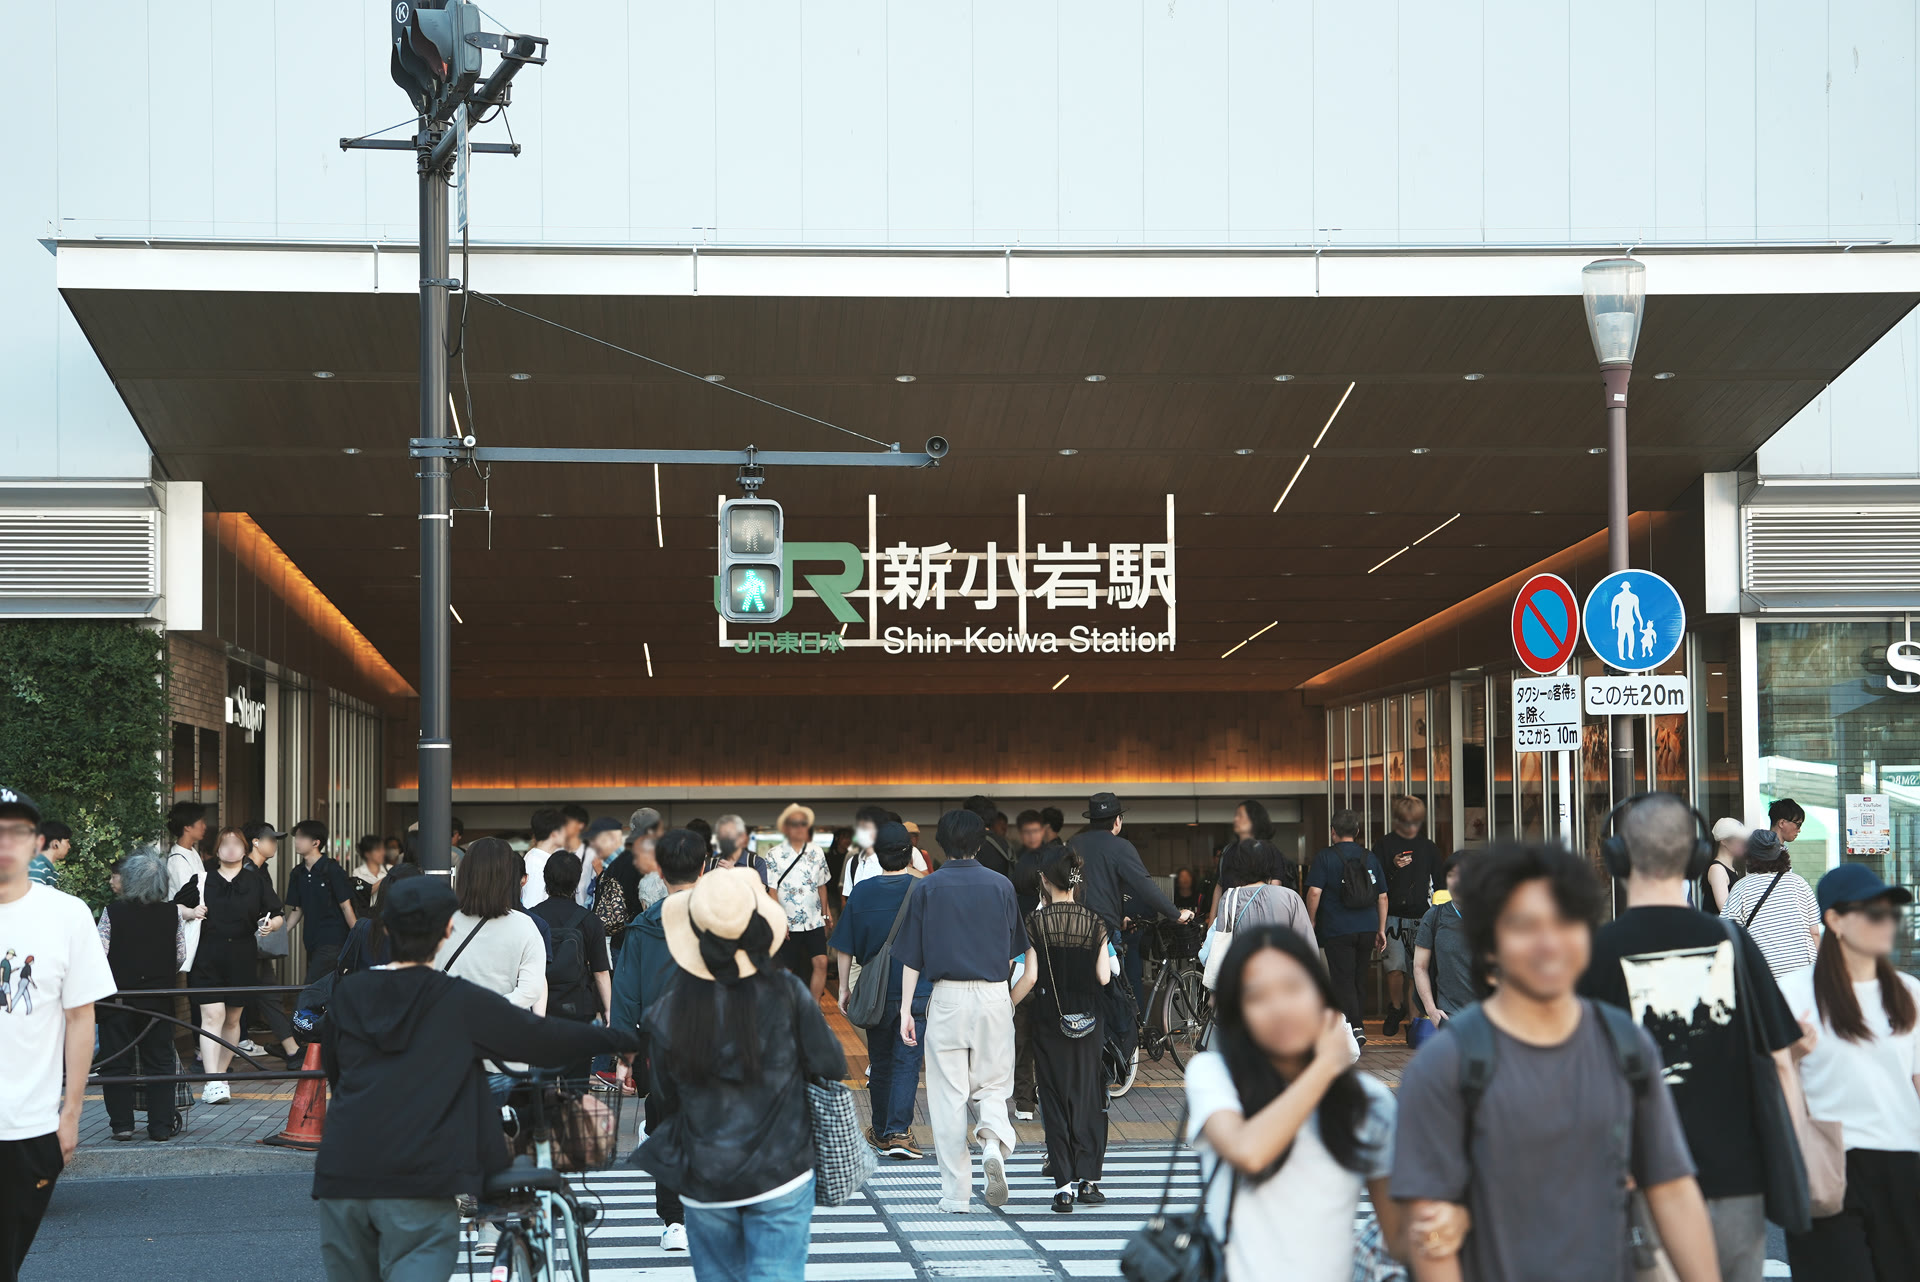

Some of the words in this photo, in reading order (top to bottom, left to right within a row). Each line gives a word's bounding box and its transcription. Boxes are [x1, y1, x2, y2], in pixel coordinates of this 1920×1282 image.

[883, 541, 1176, 610] 新小岩駅
[734, 631, 845, 653] JR東日本
[883, 626, 1058, 654] Shin-Koiwa
[1069, 625, 1176, 652] Station
[1517, 683, 1576, 703] タクシーの客待ち
[1518, 706, 1546, 723] を除く
[1518, 728, 1551, 745] ここから
[1557, 726, 1578, 744] 10m
